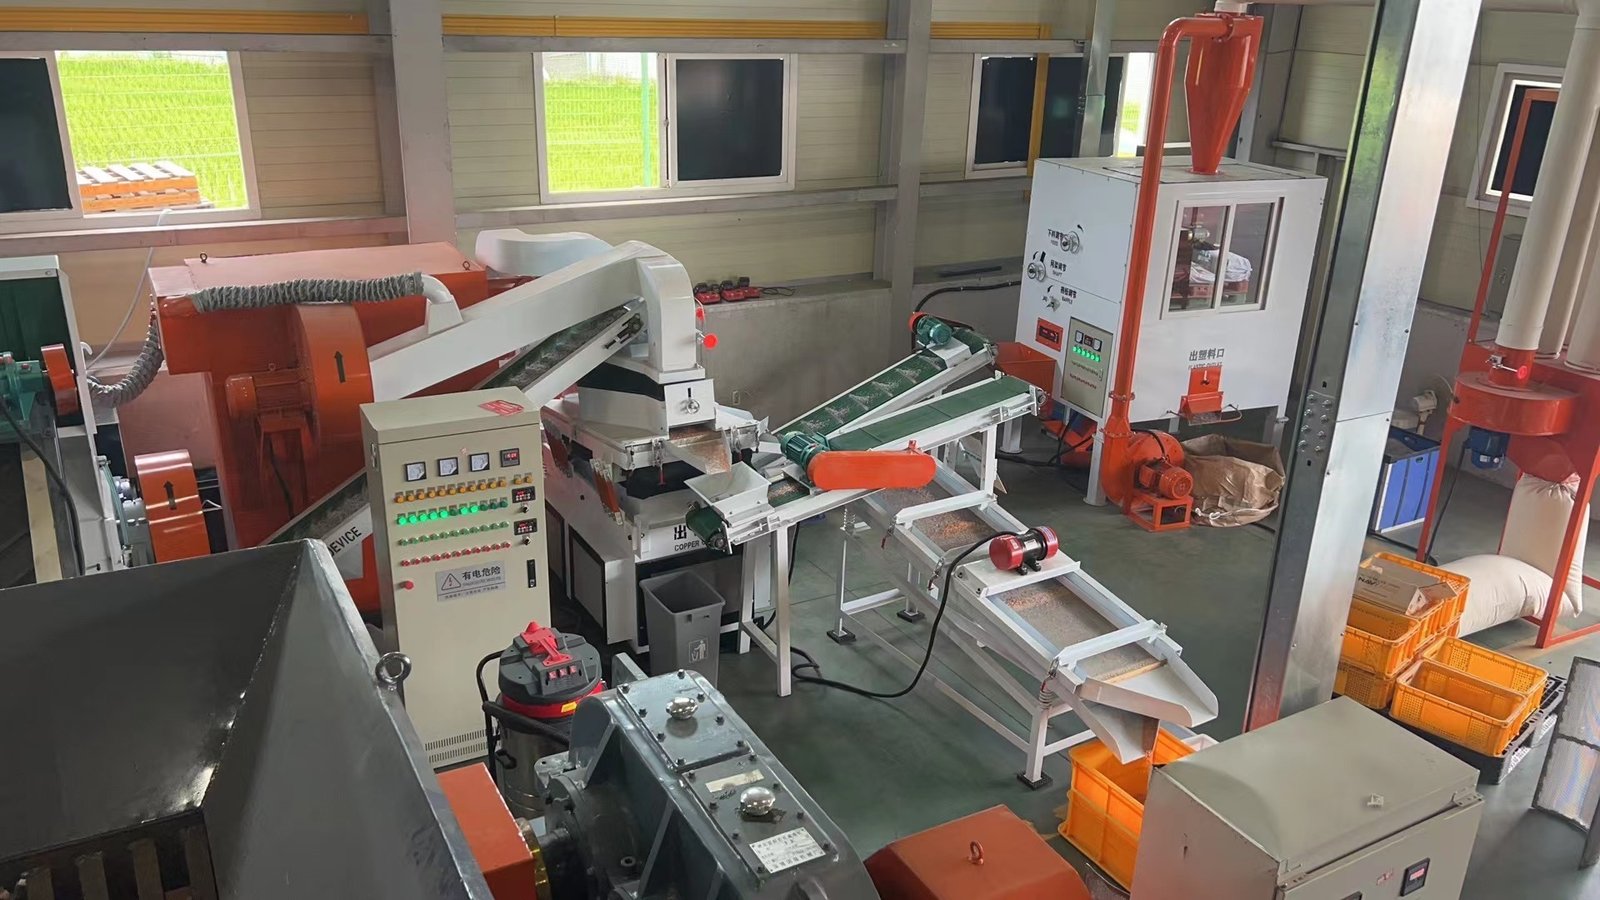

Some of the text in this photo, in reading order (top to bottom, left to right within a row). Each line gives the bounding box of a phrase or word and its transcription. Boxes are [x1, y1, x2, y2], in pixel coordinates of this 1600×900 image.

[1188, 347, 1225, 361] 出塑料口
[674, 540, 700, 551] COPPER
[462, 566, 501, 580] 有电危险
